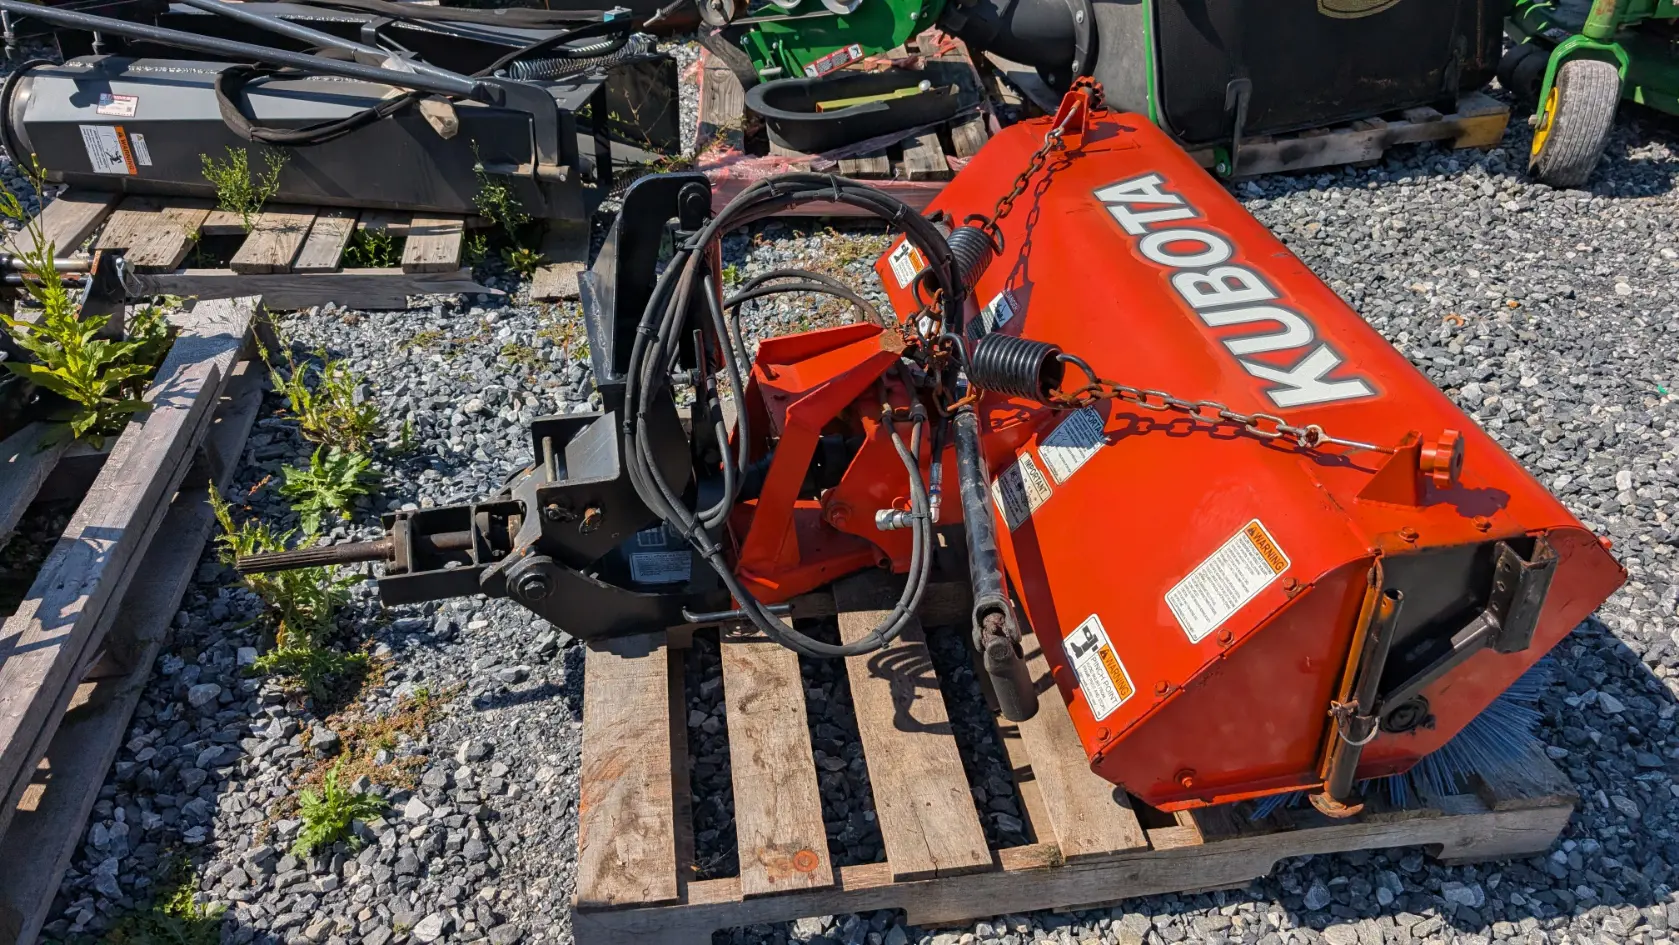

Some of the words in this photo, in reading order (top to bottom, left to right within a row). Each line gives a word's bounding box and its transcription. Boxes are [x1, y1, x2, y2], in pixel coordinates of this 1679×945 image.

[121, 139, 135, 170] WARNING
[1093, 173, 1375, 408] KUBOTA
[1025, 458, 1047, 495] IMPORTANT
[1253, 531, 1285, 571] WARNING
[1091, 656, 1106, 681] PINCH
[1103, 680, 1118, 704] POINT
[1105, 658, 1129, 696] WARNING
